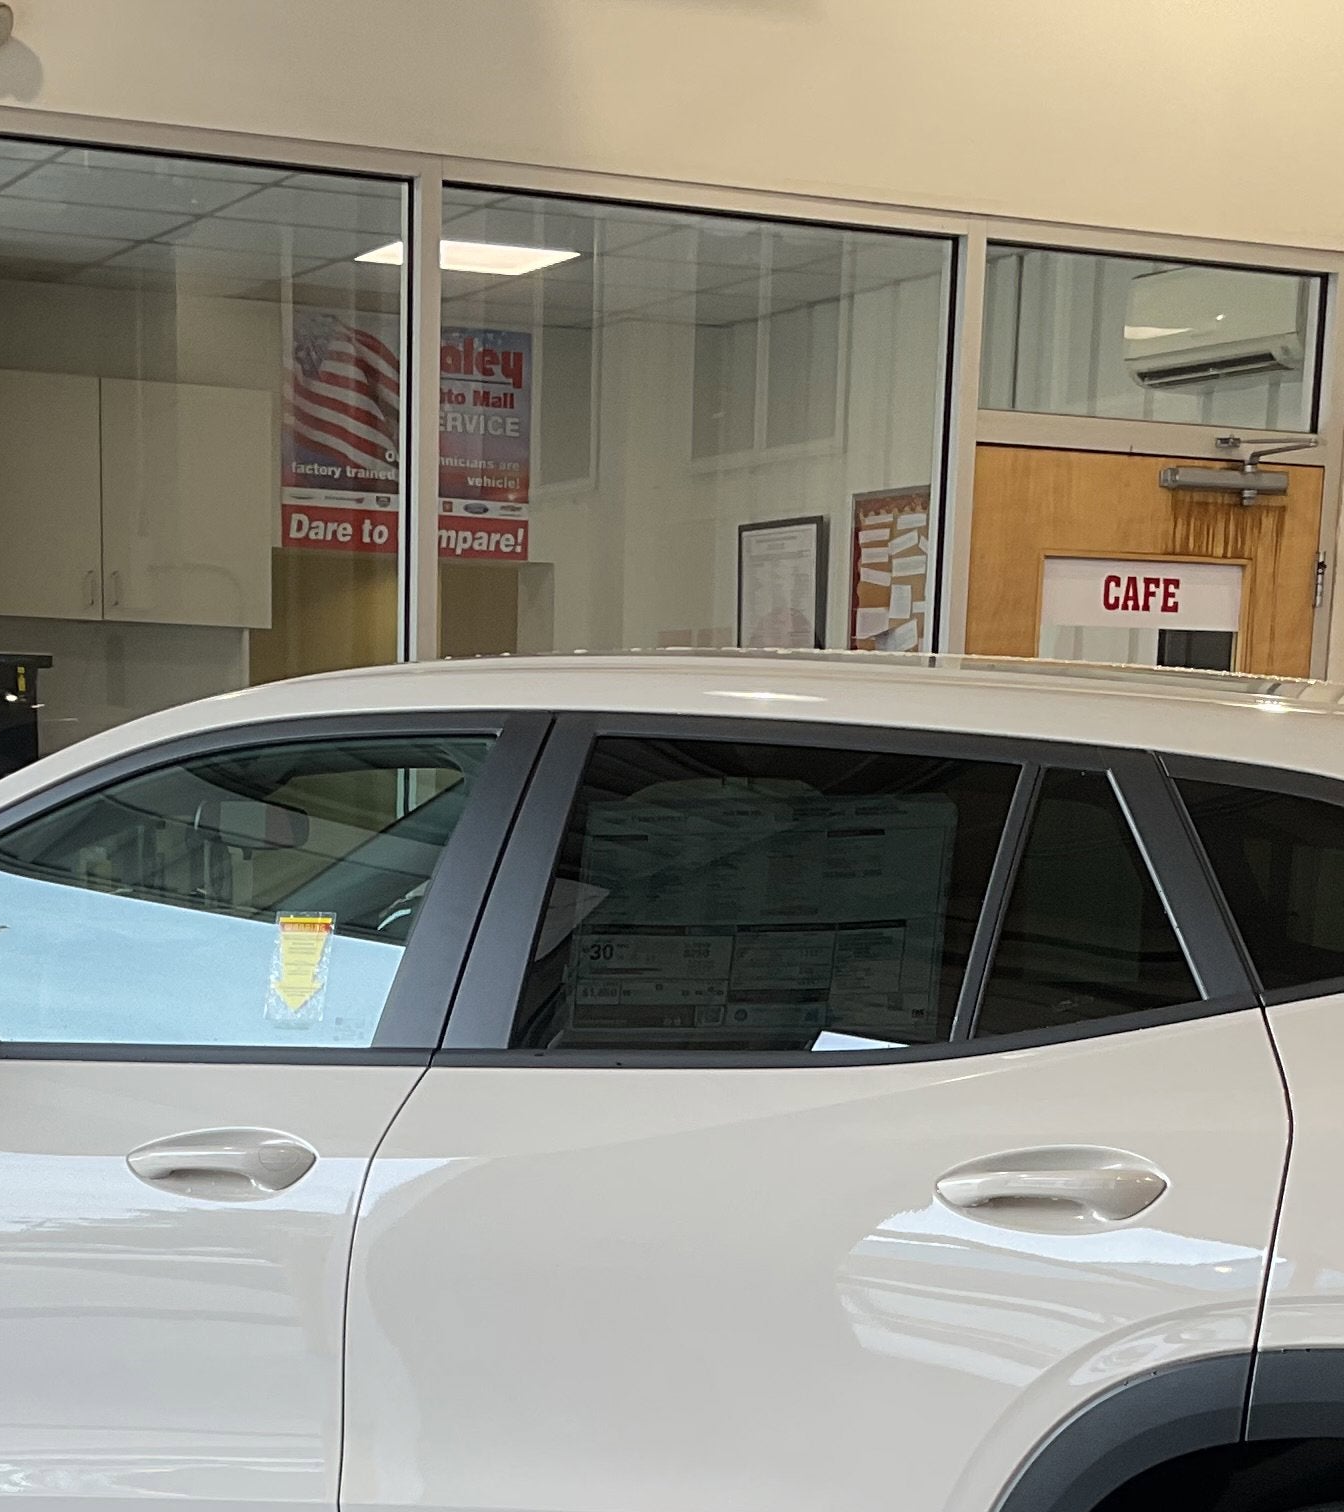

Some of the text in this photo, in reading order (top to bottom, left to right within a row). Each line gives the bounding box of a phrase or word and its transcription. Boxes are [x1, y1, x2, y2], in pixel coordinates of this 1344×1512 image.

[440, 336, 523, 389] aley
[473, 390, 514, 409] Mall
[291, 462, 521, 489] factory trained vehicle!
[289, 513, 524, 555] Dare to mpare!
[1103, 574, 1180, 613] CAFE
[590, 944, 614, 961] 30
